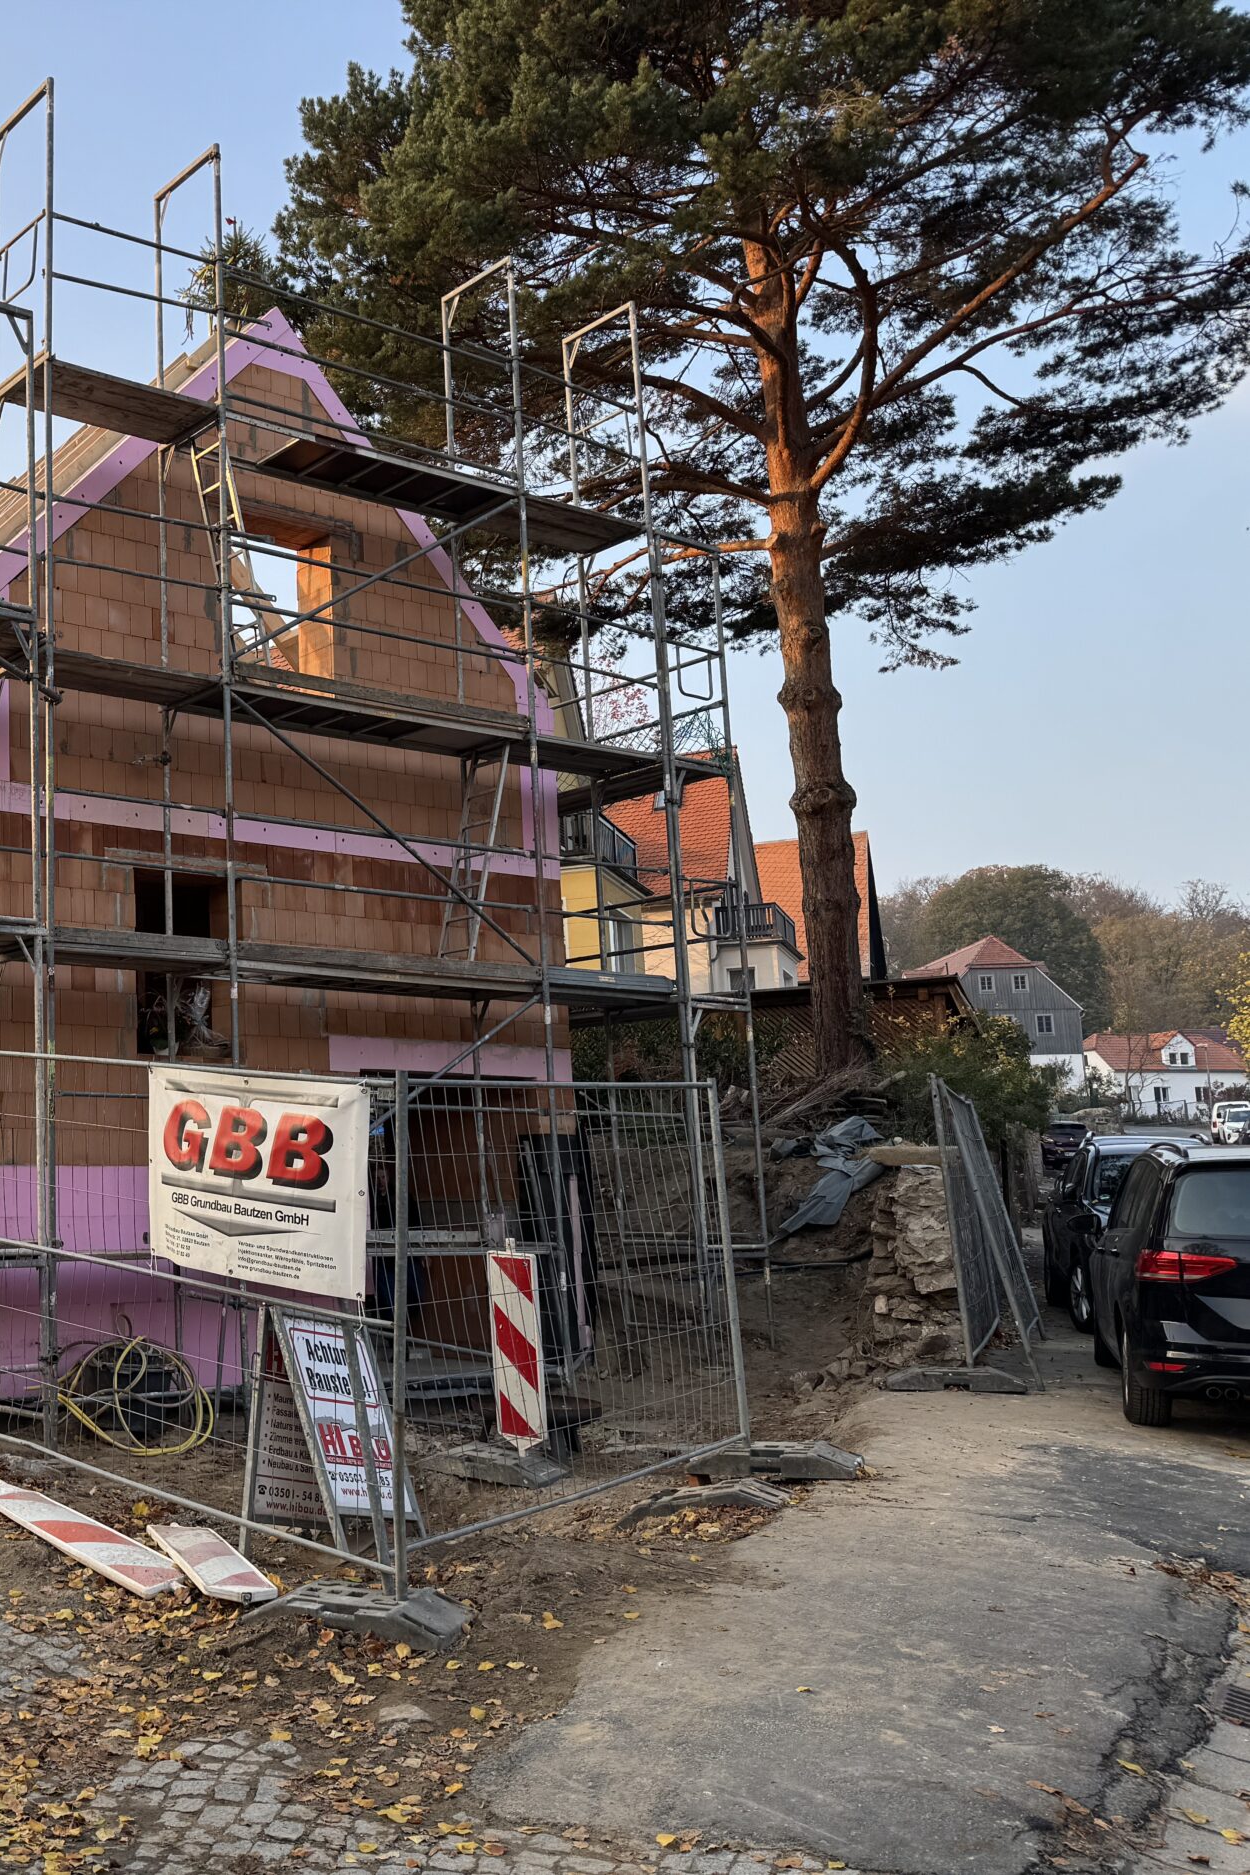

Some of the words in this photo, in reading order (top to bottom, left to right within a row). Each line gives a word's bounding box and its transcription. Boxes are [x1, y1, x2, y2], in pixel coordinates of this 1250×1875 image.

[164, 1099, 333, 1190] GBB
[171, 1192, 189, 1205] GBB
[190, 1196, 232, 1213] Grundbau
[234, 1203, 273, 1220] Bautzen
[275, 1210, 309, 1226] GmbH
[266, 1245, 334, 1262] Spundwandkonstruktionen
[306, 1260, 337, 1270] Spritzbeton
[305, 1338, 348, 1366] Achtun
[273, 1393, 294, 1405] Maure
[271, 1406, 300, 1419] Fassade
[268, 1444, 293, 1458] Erdbau
[318, 1423, 347, 1456] HI
[348, 1434, 391, 1462] BU
[267, 1458, 294, 1471] Neubau
[300, 1464, 314, 1474] San
[265, 1500, 327, 1517] www.hibau.de
